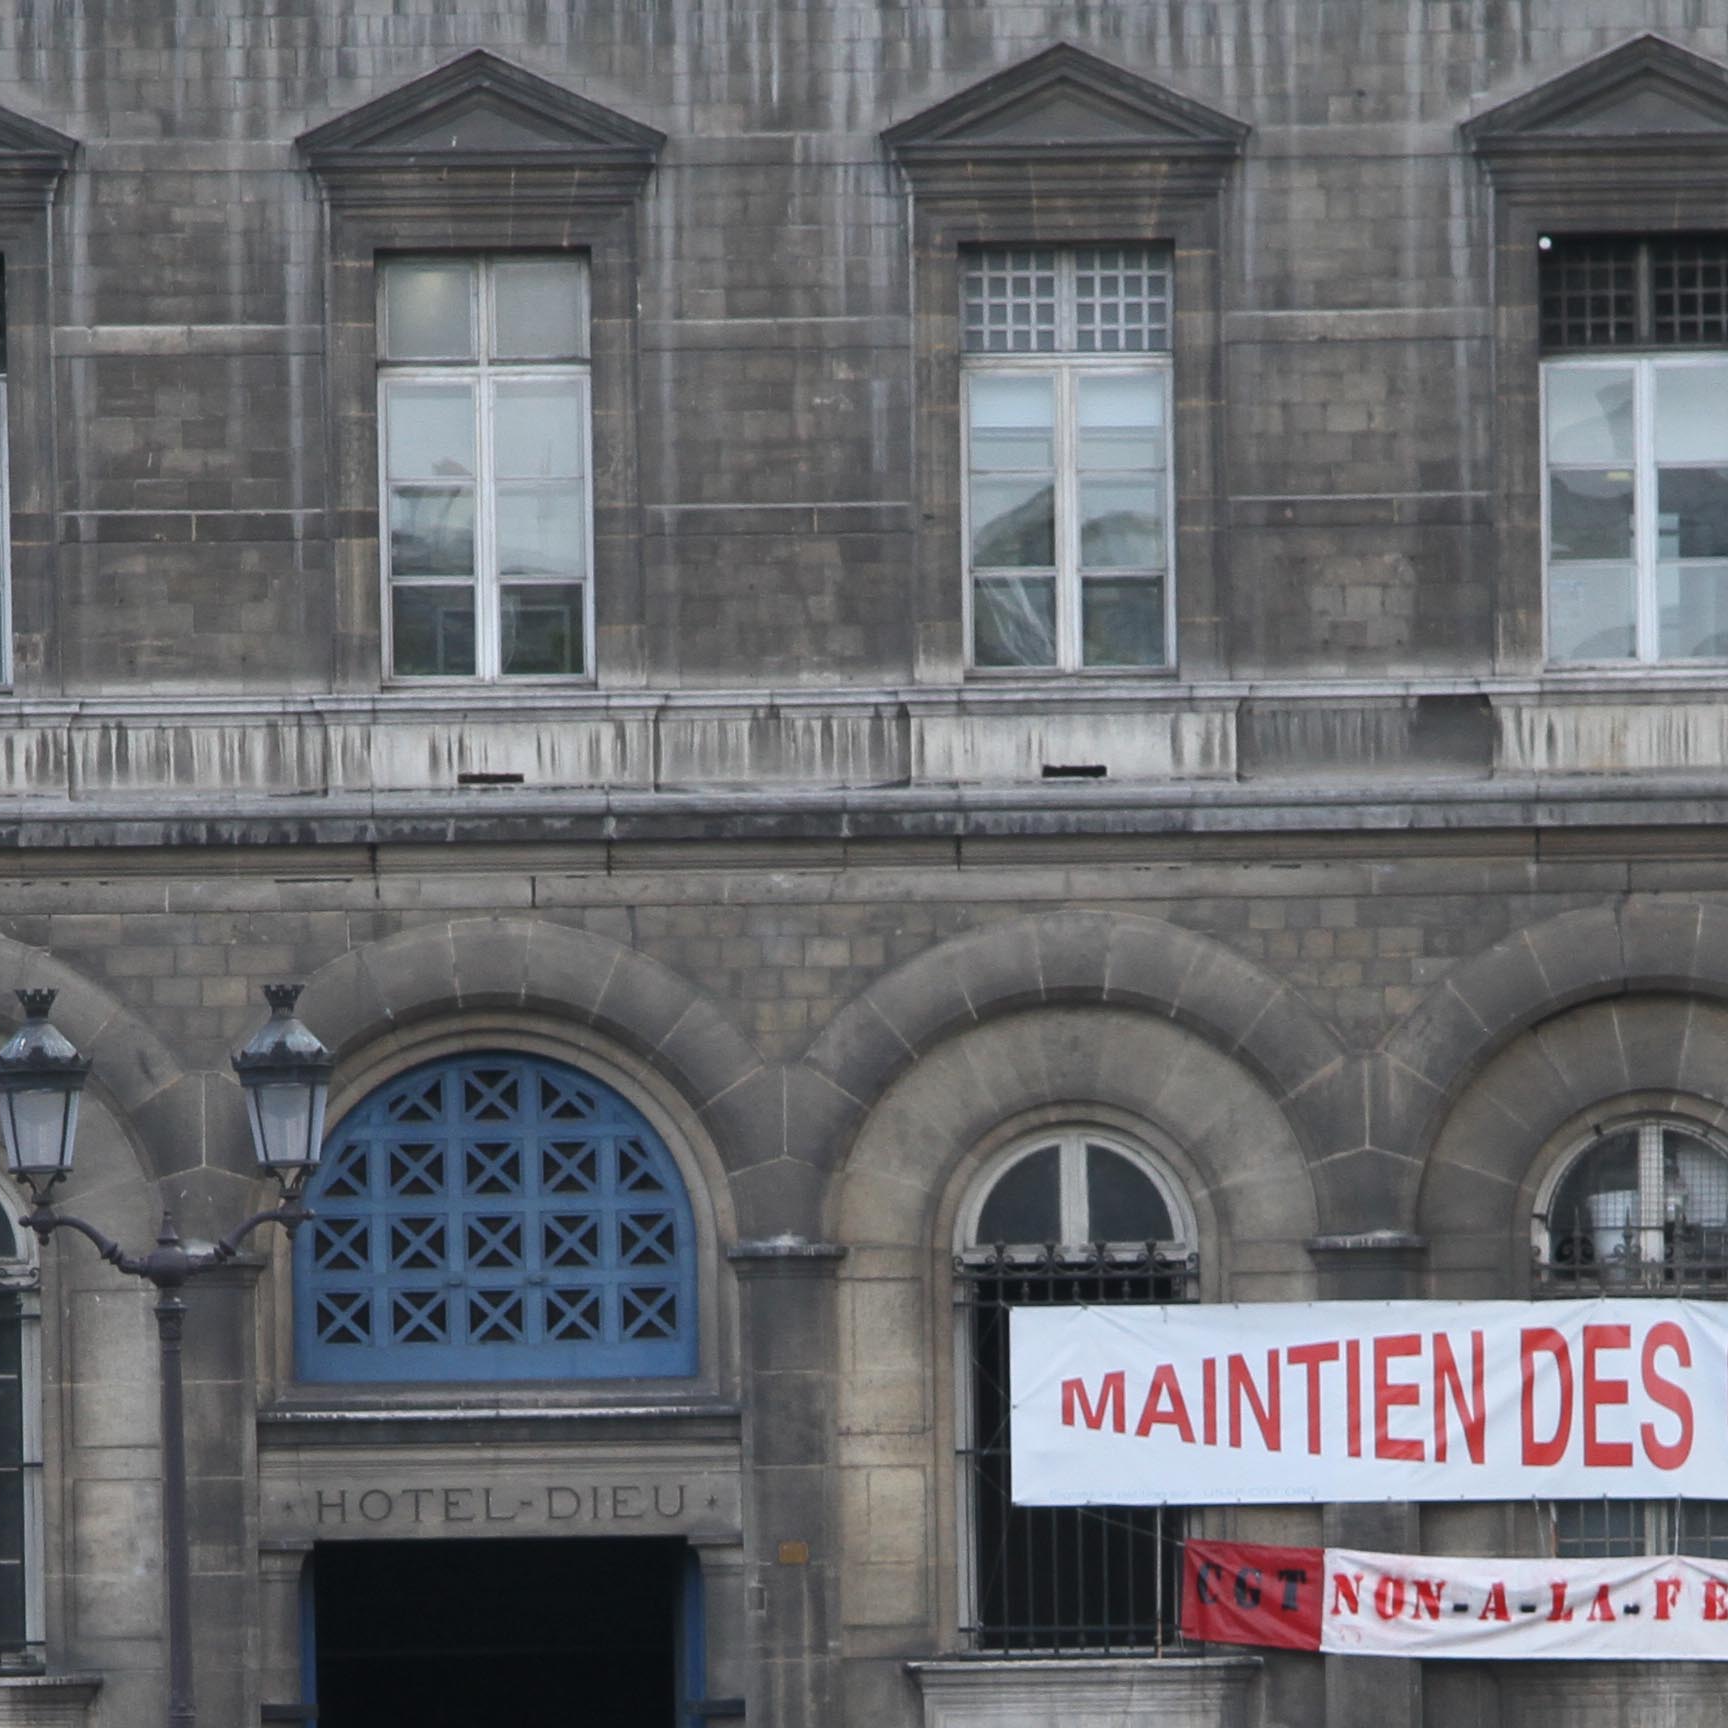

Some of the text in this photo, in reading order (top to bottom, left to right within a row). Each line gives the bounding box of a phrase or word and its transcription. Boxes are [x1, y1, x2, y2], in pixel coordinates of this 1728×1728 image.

[1062, 1331, 1486, 1465] MAINTIEN
[1520, 1322, 1694, 1470] DES
[315, 1484, 688, 1524] HOTEL-DIEU
[1195, 1561, 1306, 1611] CGT
